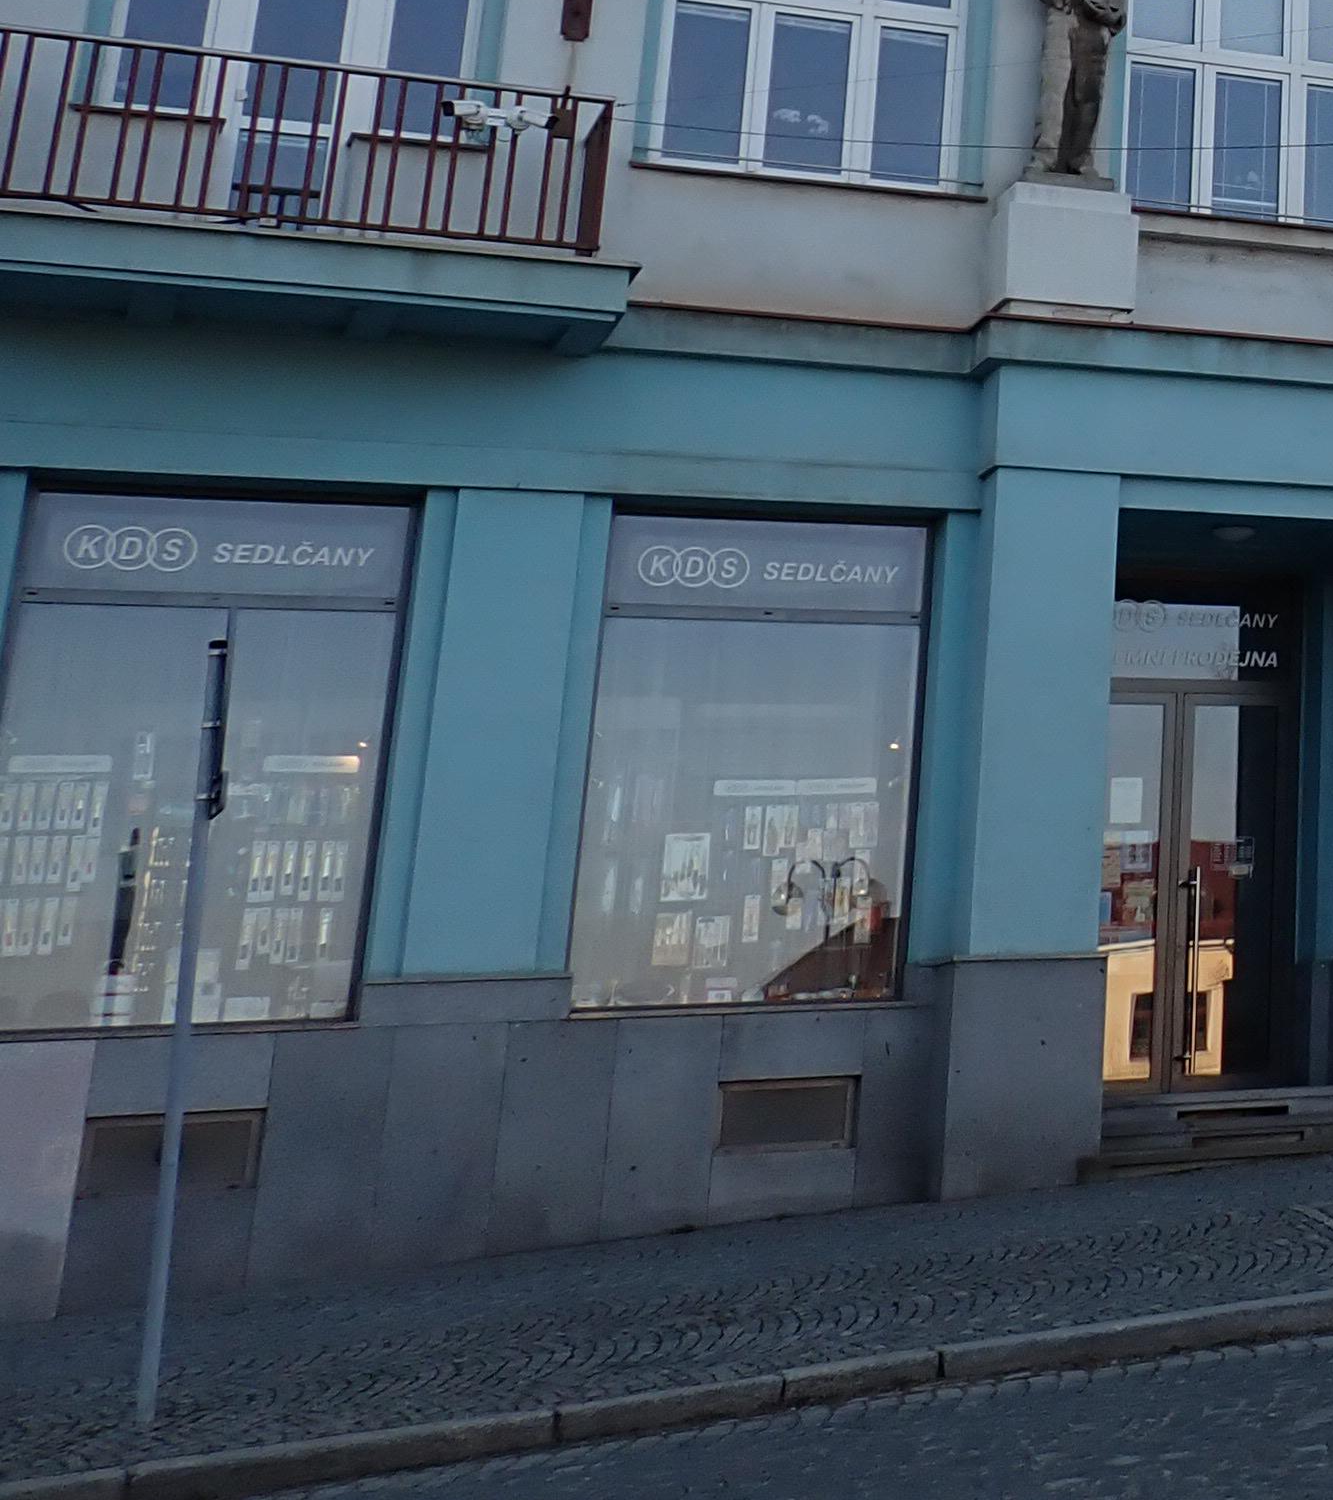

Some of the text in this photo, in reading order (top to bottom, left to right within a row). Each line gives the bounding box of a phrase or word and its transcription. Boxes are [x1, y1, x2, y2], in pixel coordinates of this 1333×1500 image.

[70, 529, 374, 567] KDS SEDLČANY
[644, 550, 899, 584] KDS SEDLČANY
[1176, 609, 1279, 629] SEDLČANY
[1171, 650, 1279, 668] PRODEJNA
